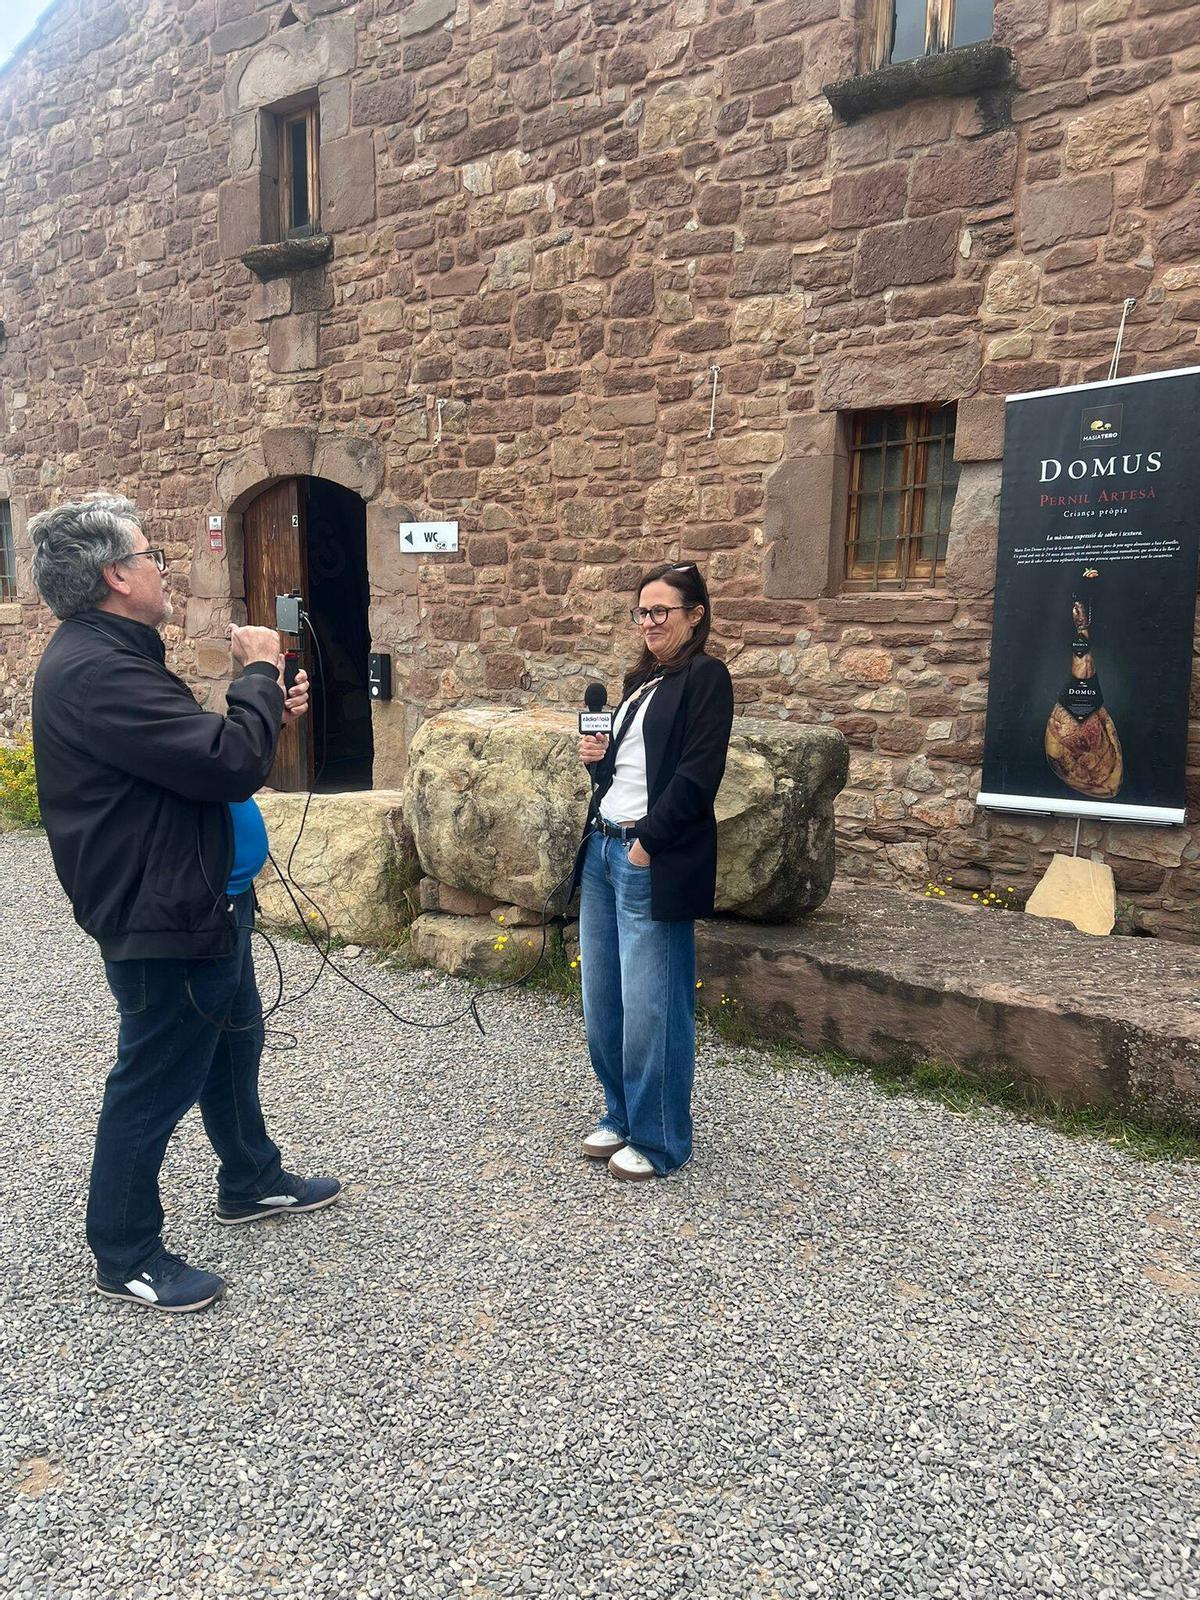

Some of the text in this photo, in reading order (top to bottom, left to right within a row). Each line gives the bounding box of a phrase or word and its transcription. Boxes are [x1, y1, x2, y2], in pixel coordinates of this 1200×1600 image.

[1063, 507, 1128, 518] Criança pròpia
[293, 516, 298, 525] 2
[424, 532, 438, 542] WC
